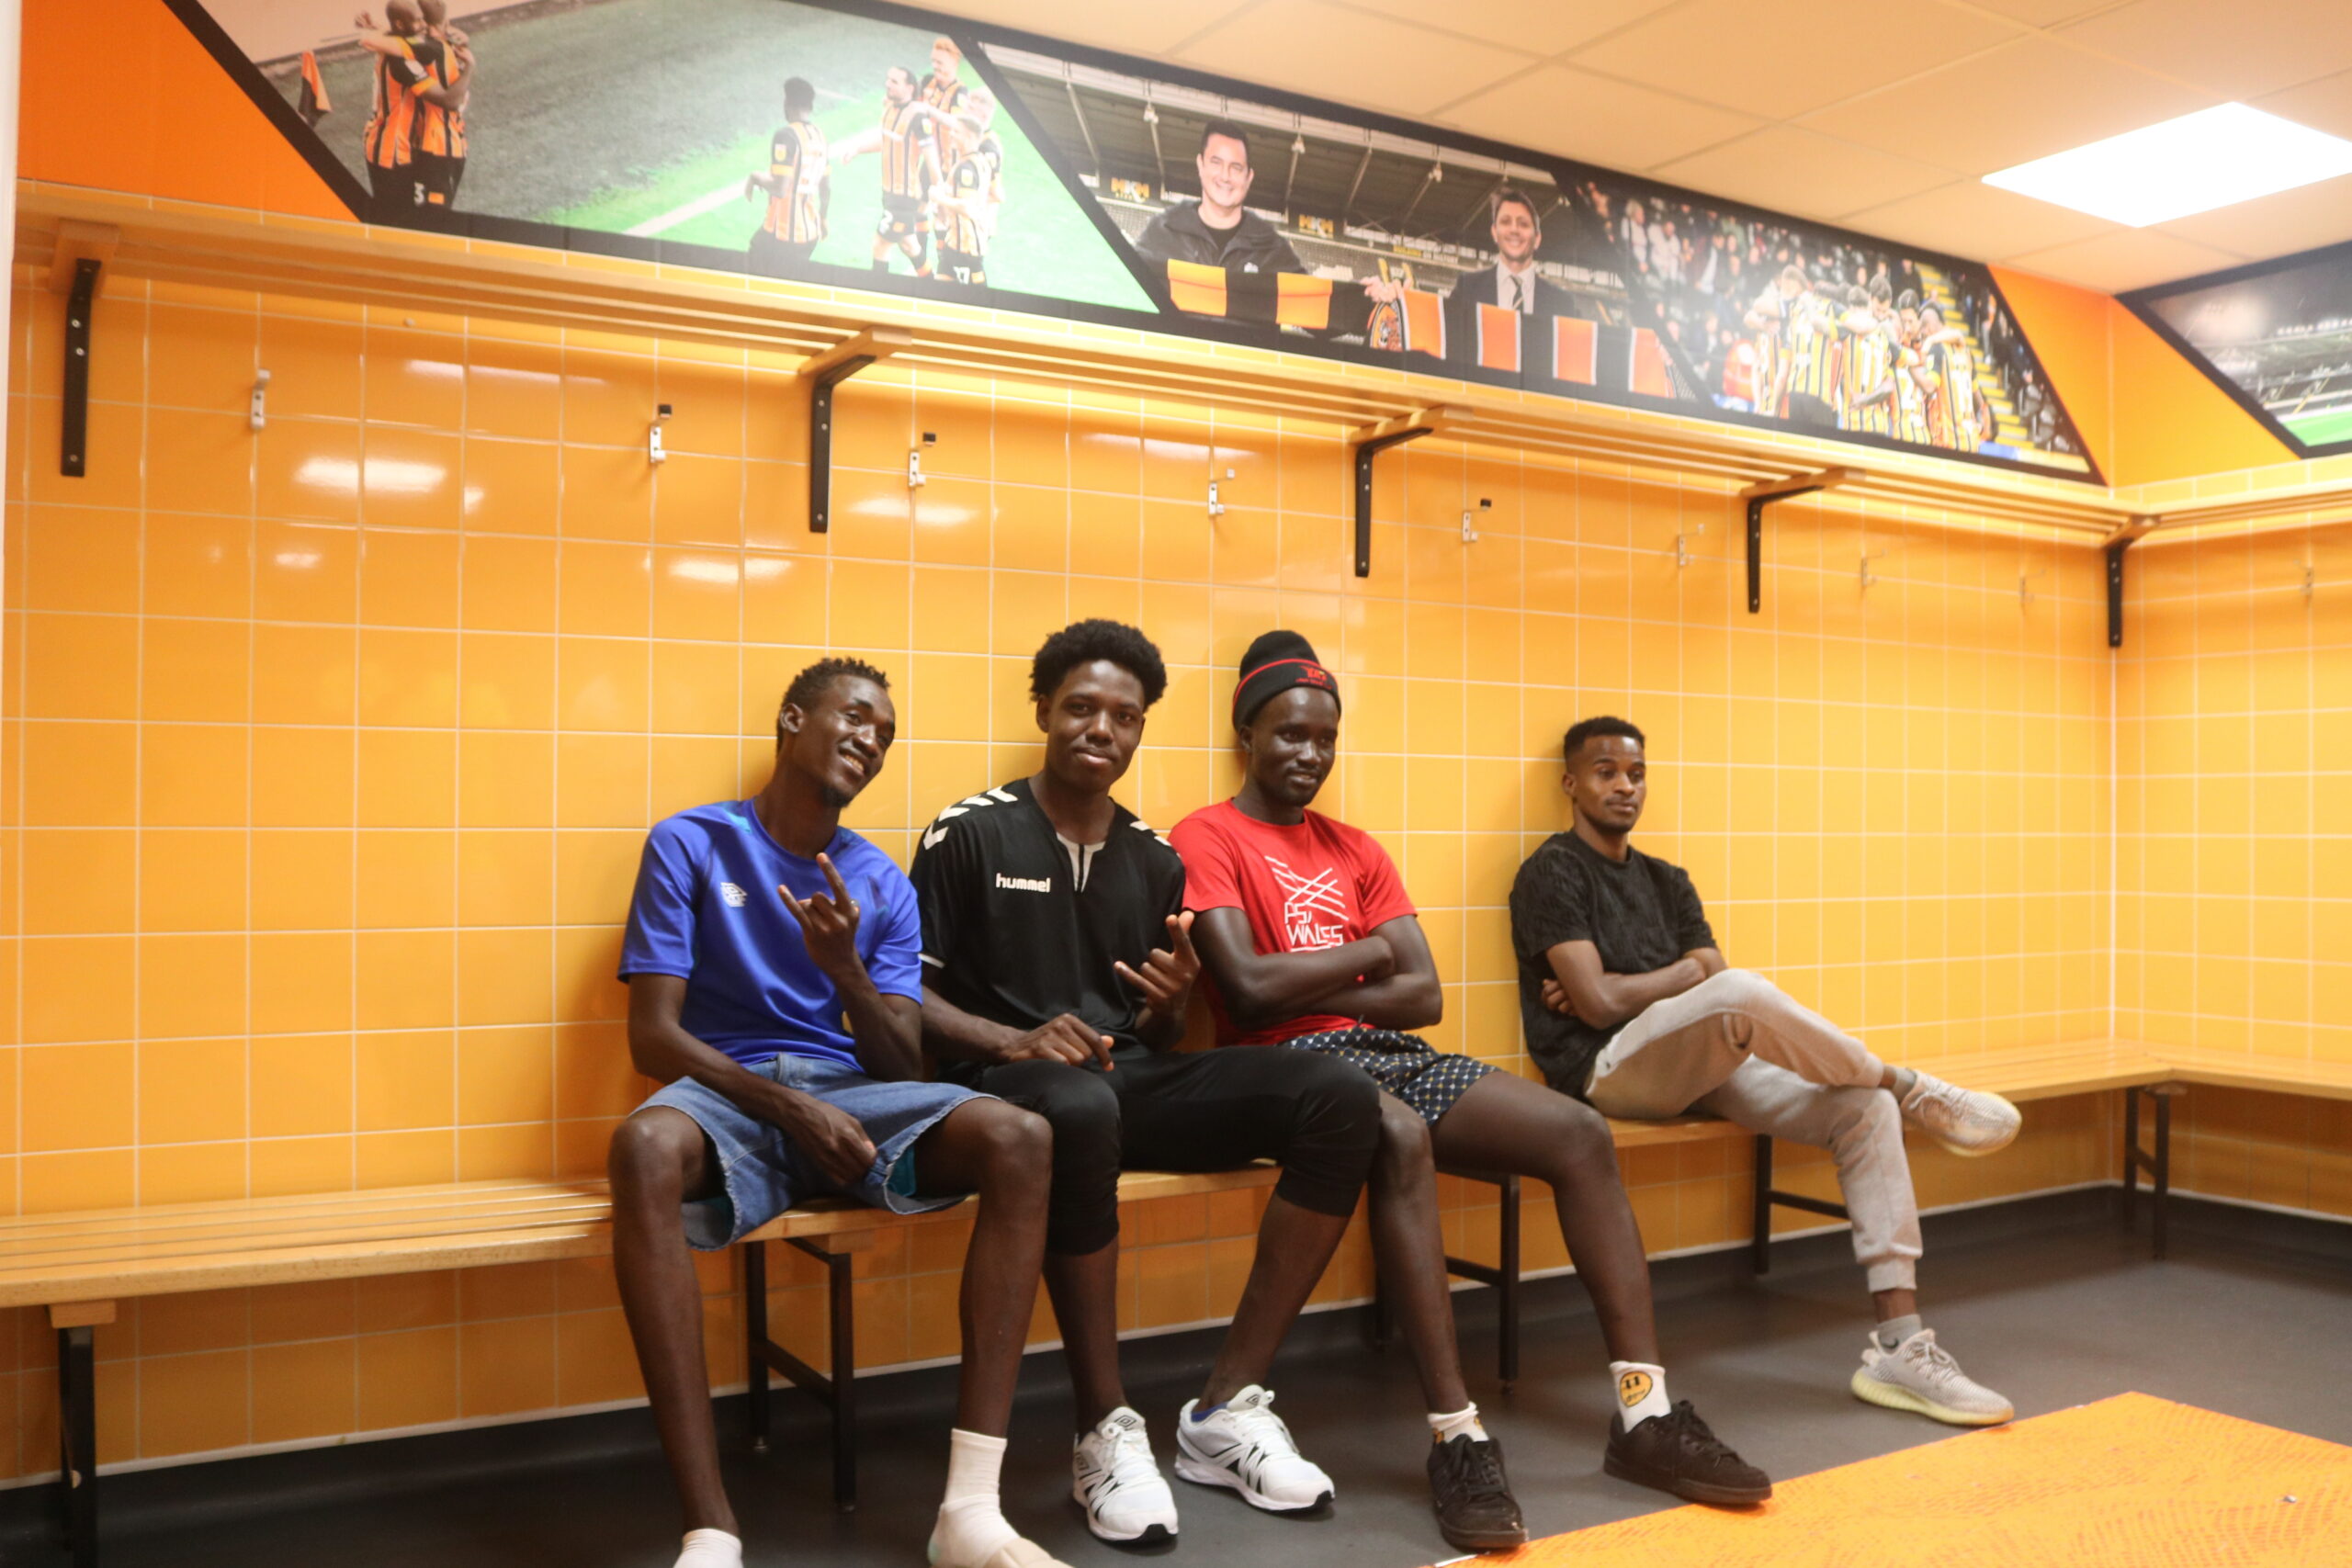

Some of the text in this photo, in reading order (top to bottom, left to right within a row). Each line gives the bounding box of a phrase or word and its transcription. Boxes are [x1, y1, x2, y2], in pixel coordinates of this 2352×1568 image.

[414, 182, 425, 205] 3
[995, 872, 1051, 893] hummel
[1286, 923, 1343, 947] WALES
